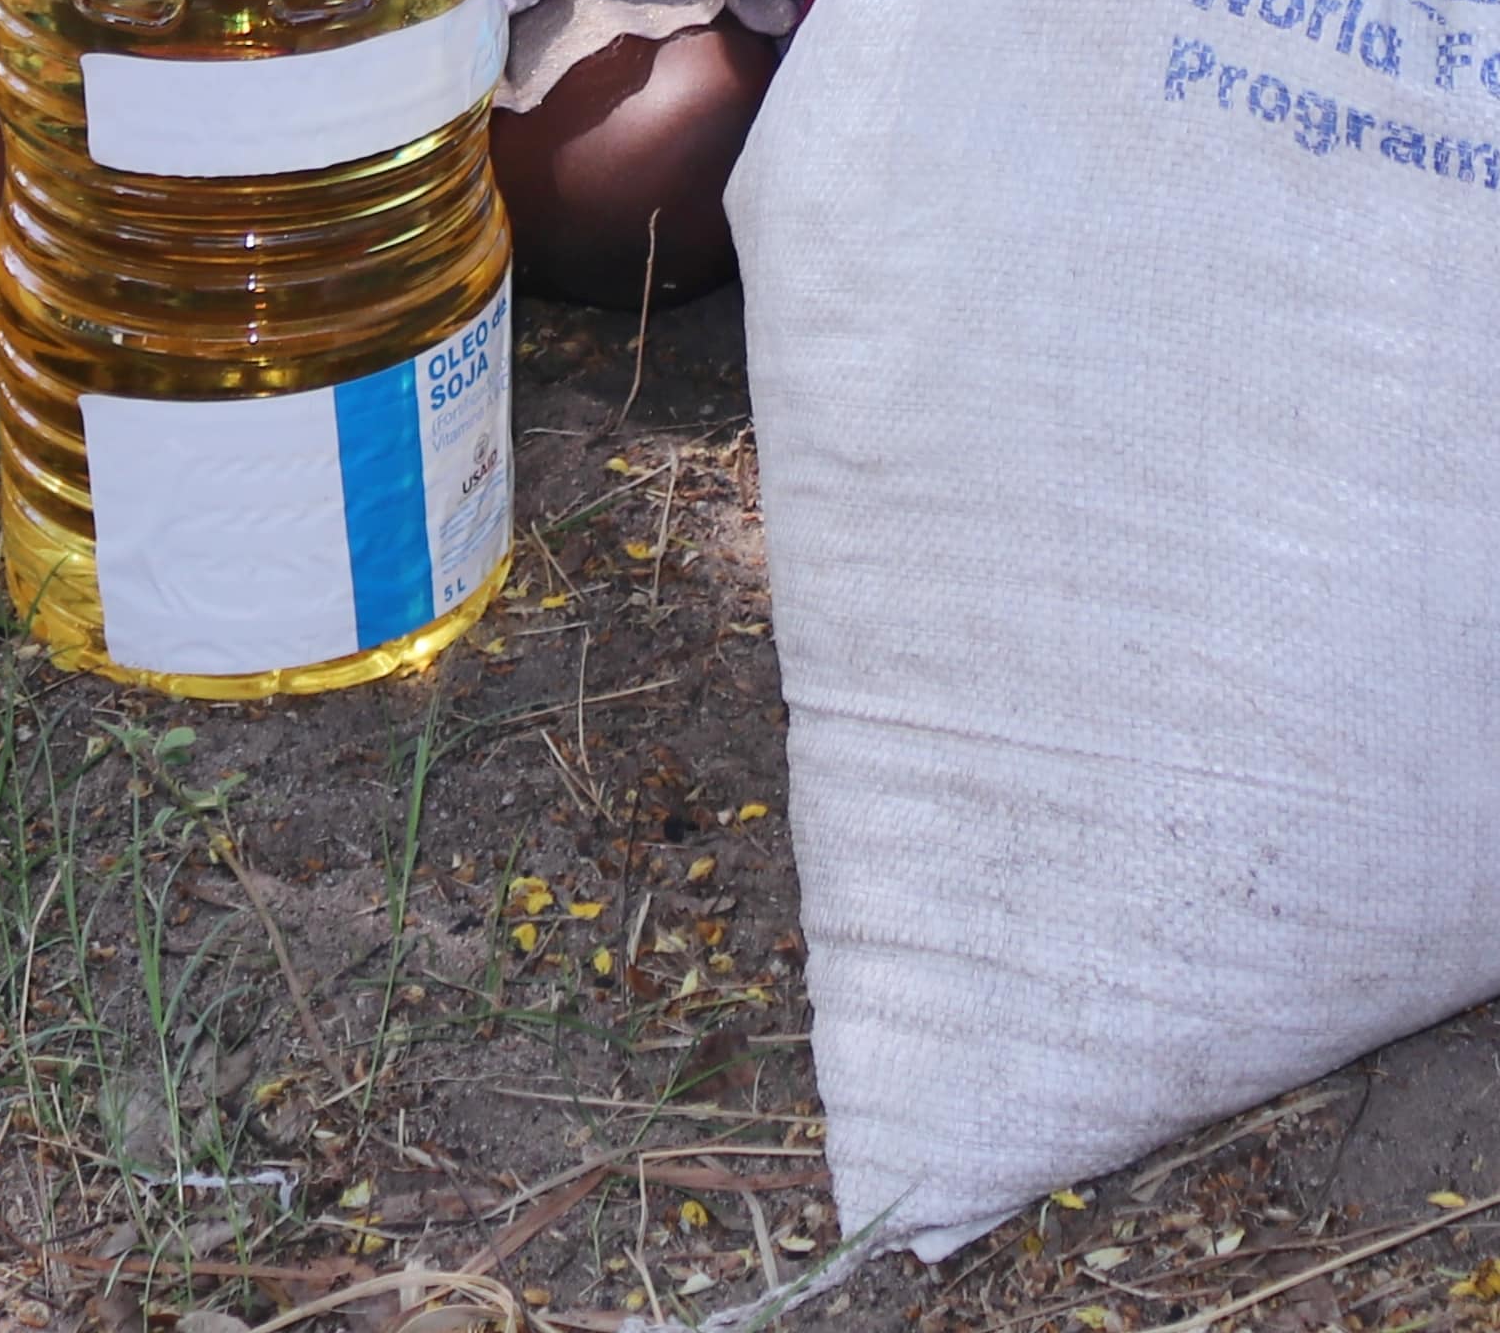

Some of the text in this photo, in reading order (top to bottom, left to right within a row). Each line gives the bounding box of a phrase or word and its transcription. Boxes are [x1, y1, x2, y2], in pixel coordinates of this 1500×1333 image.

[428, 319, 489, 381] OLEO
[429, 358, 490, 411] SOJA
[461, 448, 499, 495] USAID
[443, 577, 466, 603] 5 L
